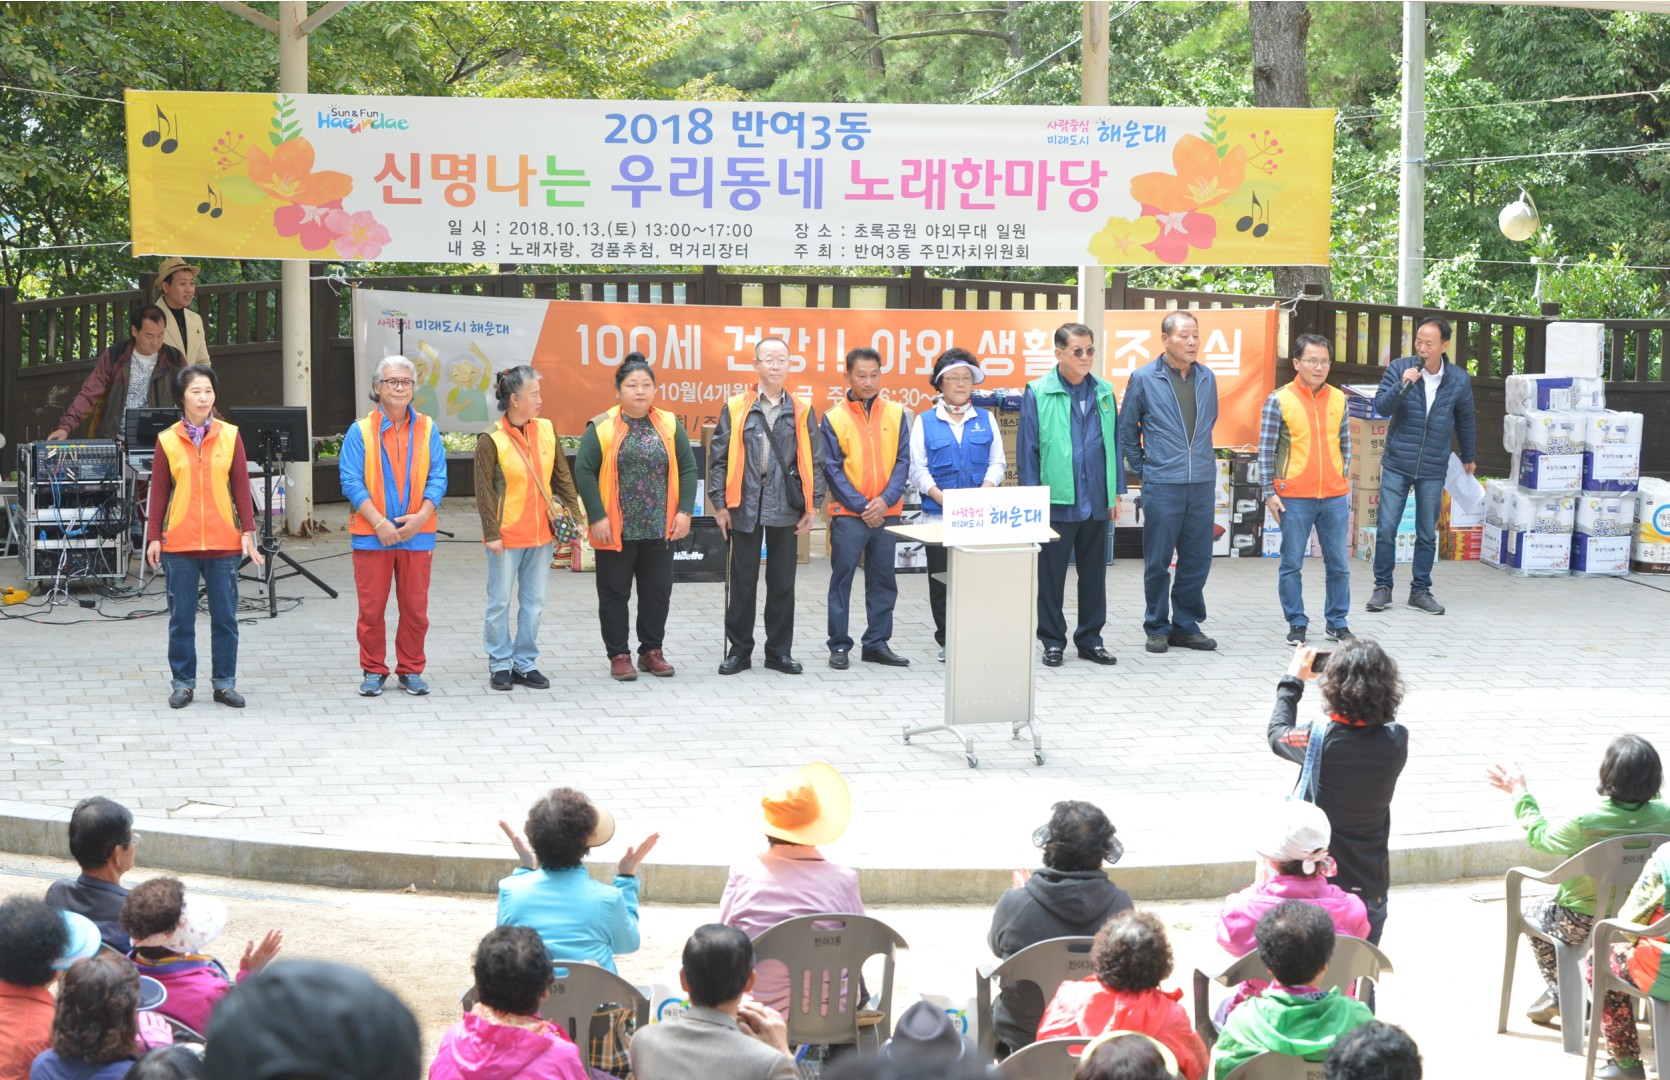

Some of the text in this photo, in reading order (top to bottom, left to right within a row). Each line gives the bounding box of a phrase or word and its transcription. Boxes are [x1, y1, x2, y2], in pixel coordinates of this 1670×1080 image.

[330, 107, 350, 117] Sun
[359, 108, 379, 118] Fun
[317, 111, 410, 134] Haeundae
[604, 107, 872, 151] 2018 반여3동
[1046, 118, 1091, 133] 사람중심
[1046, 134, 1091, 146] 미래도시
[1096, 119, 1167, 148] 해운대
[373, 152, 1108, 213] 신명나는 우리동네 노래한마당
[509, 220, 637, 238] 2018.10.13.(토)
[645, 222, 753, 238] 13:00~17:00
[853, 222, 917, 240] 초록공원
[925, 222, 988, 240] 야외무대
[996, 222, 1027, 240] 일원
[509, 241, 581, 259] 노래자랑,
[590, 242, 660, 259] 경품추첨,
[669, 242, 749, 259] 먹거리장터
[854, 243, 911, 260] 반여3동
[919, 243, 1030, 260] 주민자치위원회
[415, 320, 467, 333] 미래도시
[470, 321, 510, 337] 해운대
[576, 323, 702, 371] 100세
[1371, 425, 1386, 435] LG
[951, 506, 984, 518] 사람중심
[989, 505, 1042, 529] 해운대
[951, 519, 984, 529] 미래도시
